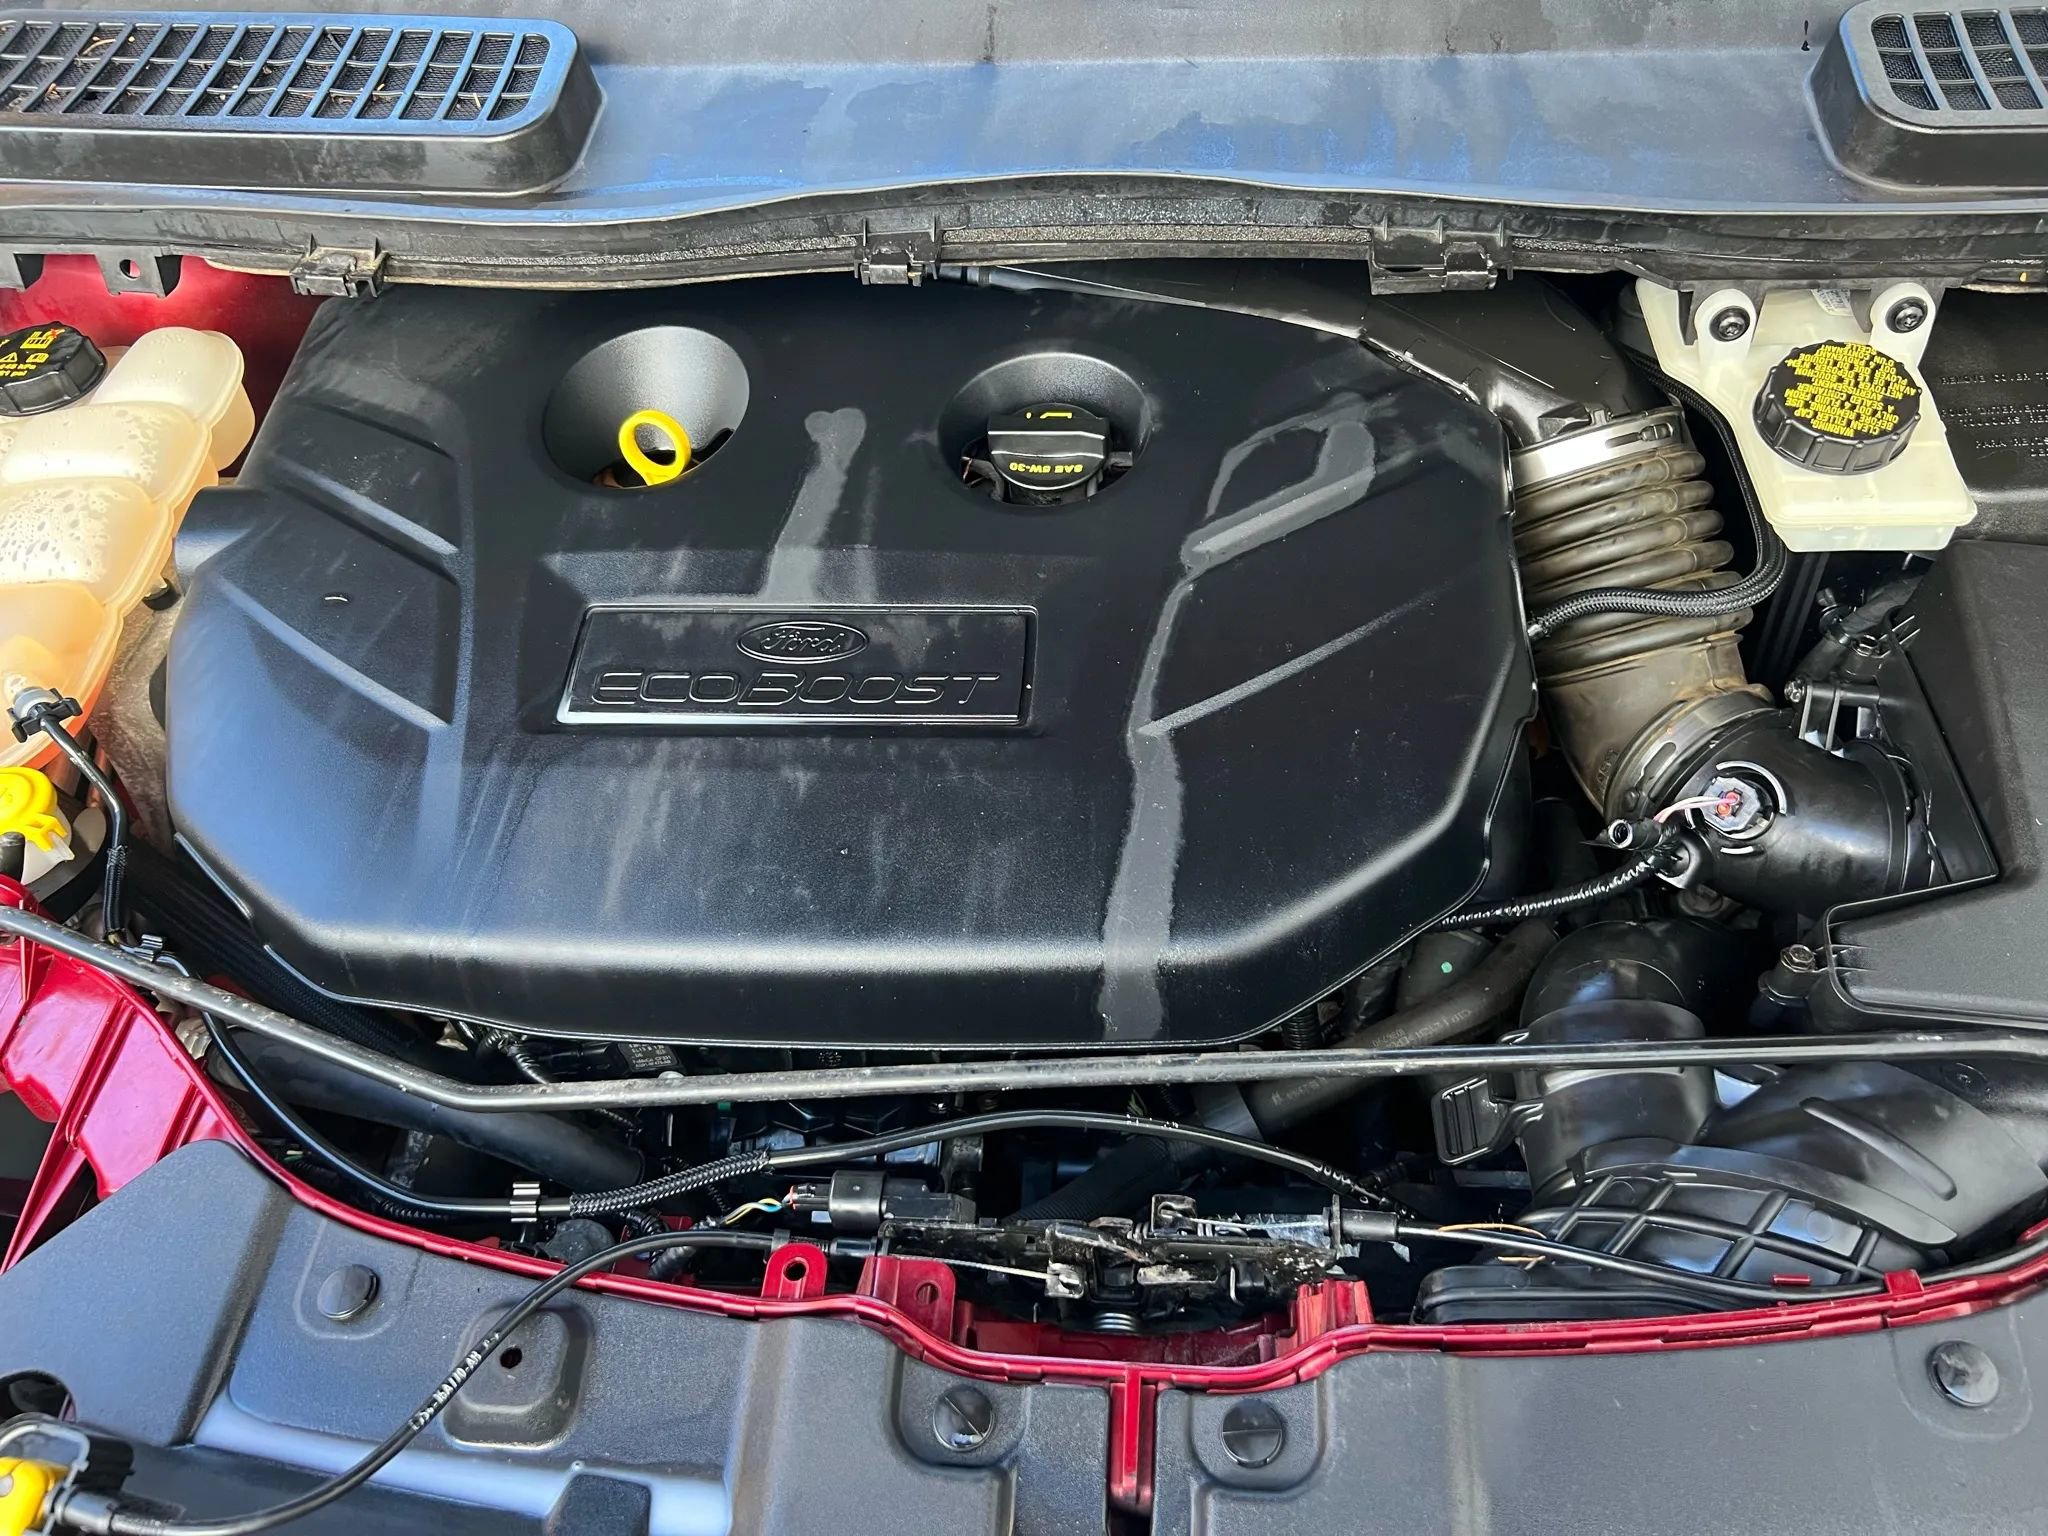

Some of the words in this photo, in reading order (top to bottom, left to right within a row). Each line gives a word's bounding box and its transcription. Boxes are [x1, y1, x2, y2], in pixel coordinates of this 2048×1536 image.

[1799, 353, 1833, 366] LIQUIDE
[1836, 360, 1849, 370] DU
[1794, 368, 1837, 382] BOUCHON
[1854, 364, 1870, 374] QUE
[1879, 364, 1896, 374] DOT
[1844, 378, 1854, 386] LE
[1858, 374, 1870, 382] LE
[1873, 376, 1884, 386] DE
[1875, 370, 1908, 386] PLOYER
[1784, 388, 1811, 401] FROM
[1858, 382, 1902, 400] NETTOYER
[1888, 382, 1916, 396] AVANT
[1785, 398, 1804, 408] USE
[1814, 394, 1840, 407] FLUID
[1844, 401, 1851, 410] 4
[1850, 396, 1884, 410] SEALED
[1794, 408, 1814, 418] CAP
[1854, 404, 1872, 416] DOT
[1888, 405, 1894, 413] A
[1816, 412, 1846, 426] FILLER
[1860, 413, 1893, 430] BEFORE
[1875, 410, 1898, 423] ONLY
[1850, 420, 1879, 434] CLEAN
[1009, 462, 1051, 474] 5W-30
[1054, 463, 1084, 474] SAE
[759, 624, 846, 653] Ford
